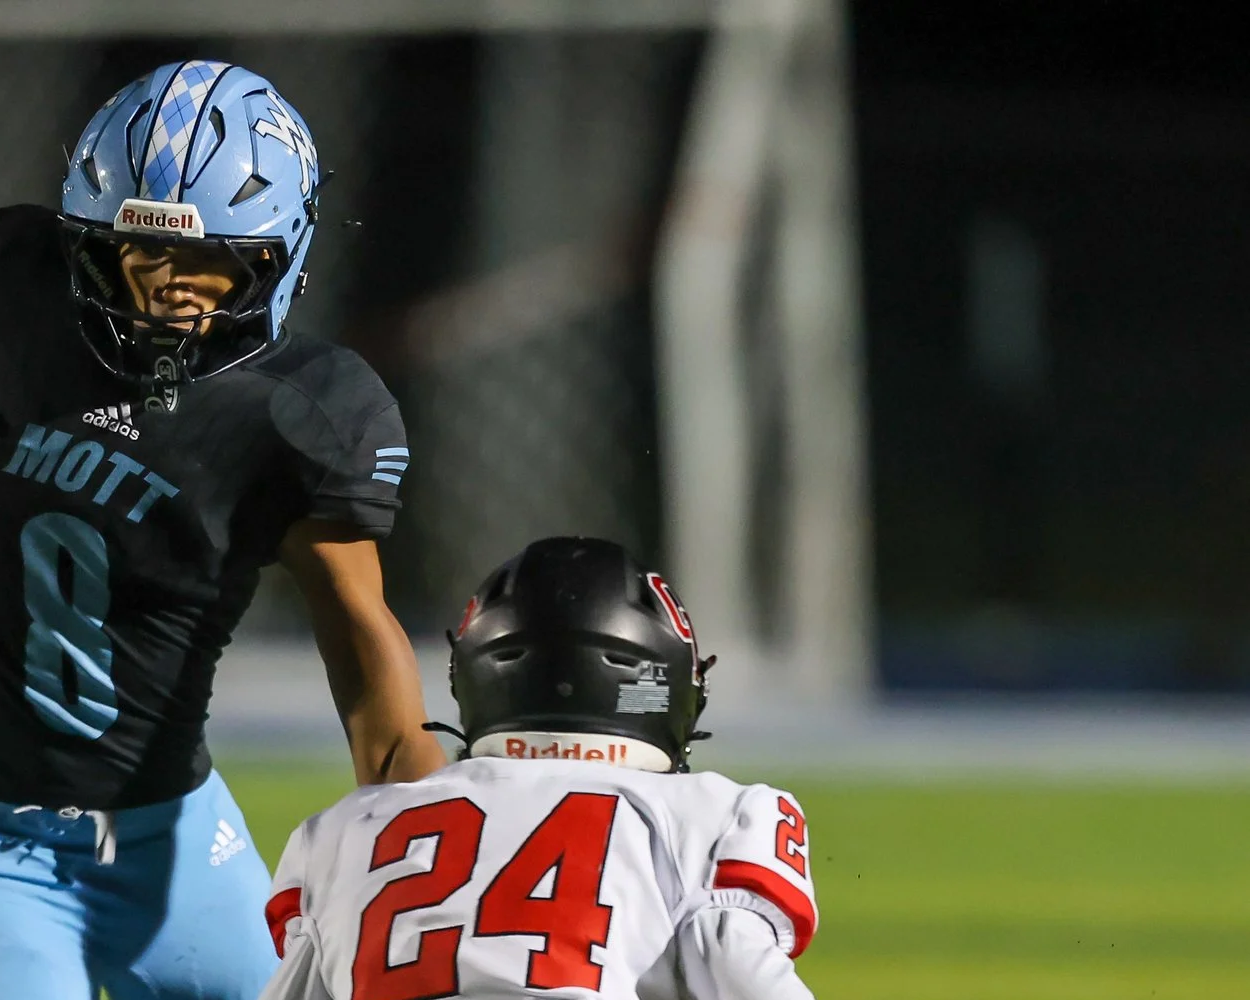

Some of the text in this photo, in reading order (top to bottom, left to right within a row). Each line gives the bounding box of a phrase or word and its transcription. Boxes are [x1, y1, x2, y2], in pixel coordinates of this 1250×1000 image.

[122, 208, 193, 229] Riddell
[82, 412, 140, 440] adidas
[2, 423, 180, 523] MOTT
[20, 511, 118, 741] 8
[775, 796, 808, 878] 2
